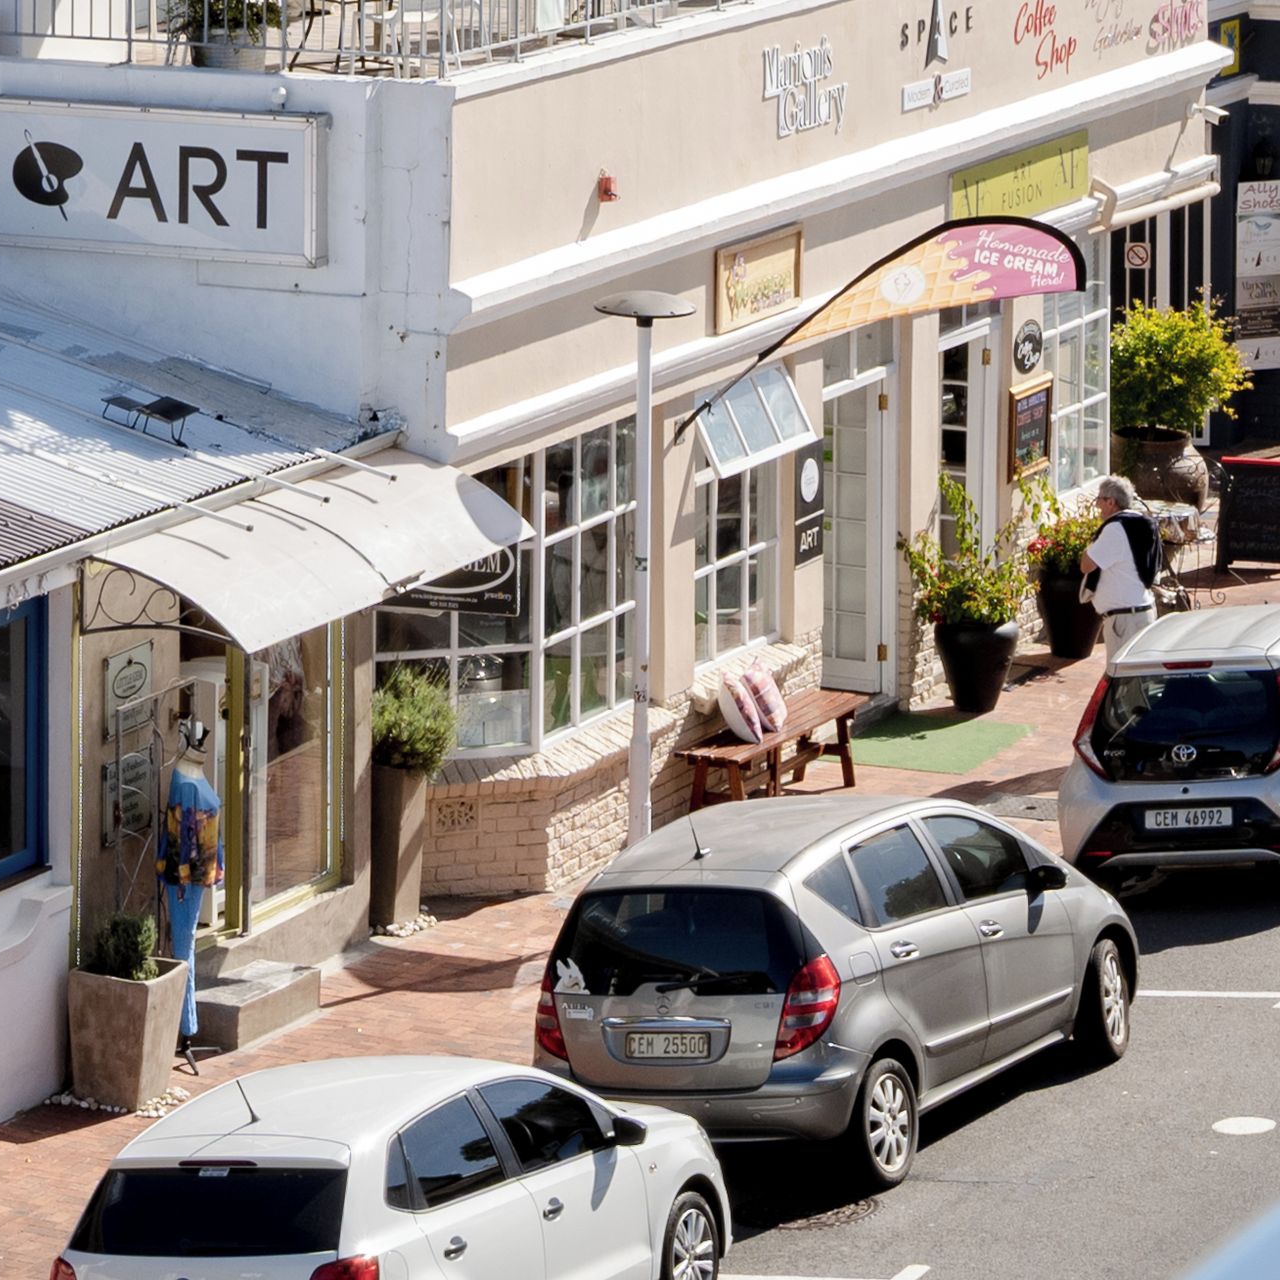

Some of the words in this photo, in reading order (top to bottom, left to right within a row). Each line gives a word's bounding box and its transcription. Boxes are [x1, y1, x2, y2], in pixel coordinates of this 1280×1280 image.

[1035, 30, 1077, 80] Shop
[777, 79, 848, 138] Gallery
[106, 141, 290, 230] ART
[1001, 181, 1042, 211] FUSION
[1244, 182, 1279, 198] Ally
[976, 229, 1071, 264] Homemade
[974, 249, 1000, 266] ICE
[1004, 254, 1058, 277] CREAM
[1030, 272, 1065, 288] Here!
[800, 526, 820, 553] ART
[1155, 811, 1178, 827] CEM
[1185, 809, 1223, 826] 46992
[628, 1034, 655, 1055] CEM
[663, 1033, 709, 1054] 25500
